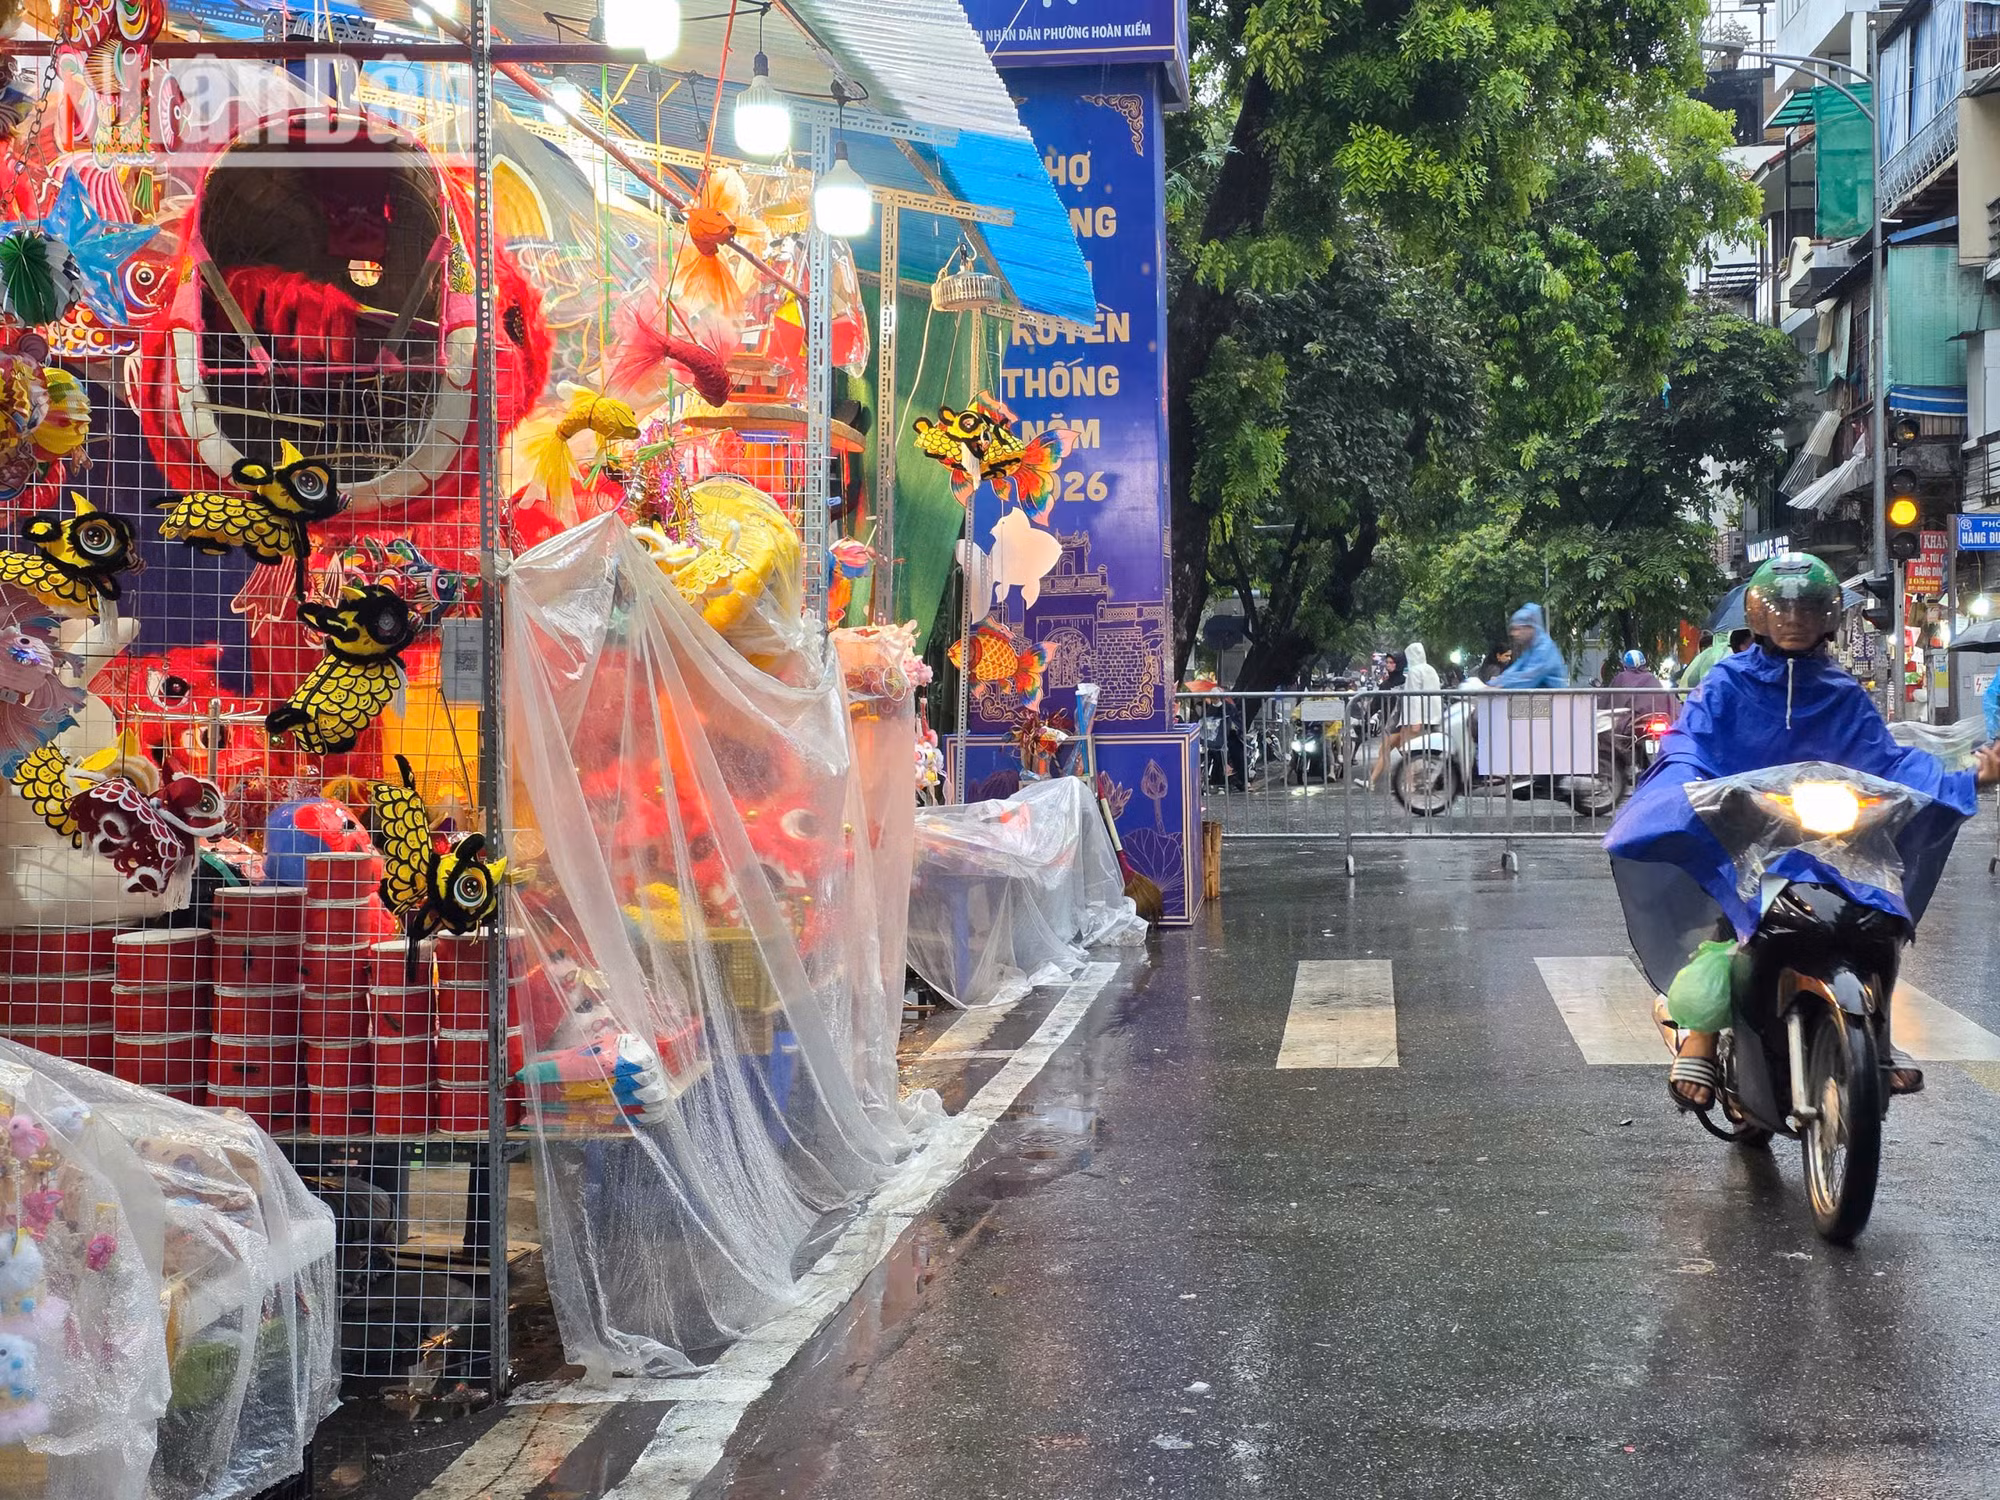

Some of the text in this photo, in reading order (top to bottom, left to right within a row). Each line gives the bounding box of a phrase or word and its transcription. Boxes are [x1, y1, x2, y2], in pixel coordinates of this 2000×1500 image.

[986, 26, 1016, 42] NHÂN
[1019, 26, 1041, 41] DÂN
[1043, 24, 1089, 40] PHƯỜNG
[1091, 23, 1122, 39] HOÀN
[1124, 19, 1151, 37] KIẾM
[1044, 150, 1091, 193] HỢ
[1001, 357, 1120, 398] THỐNG
[1962, 529, 1986, 544] HÀNG
